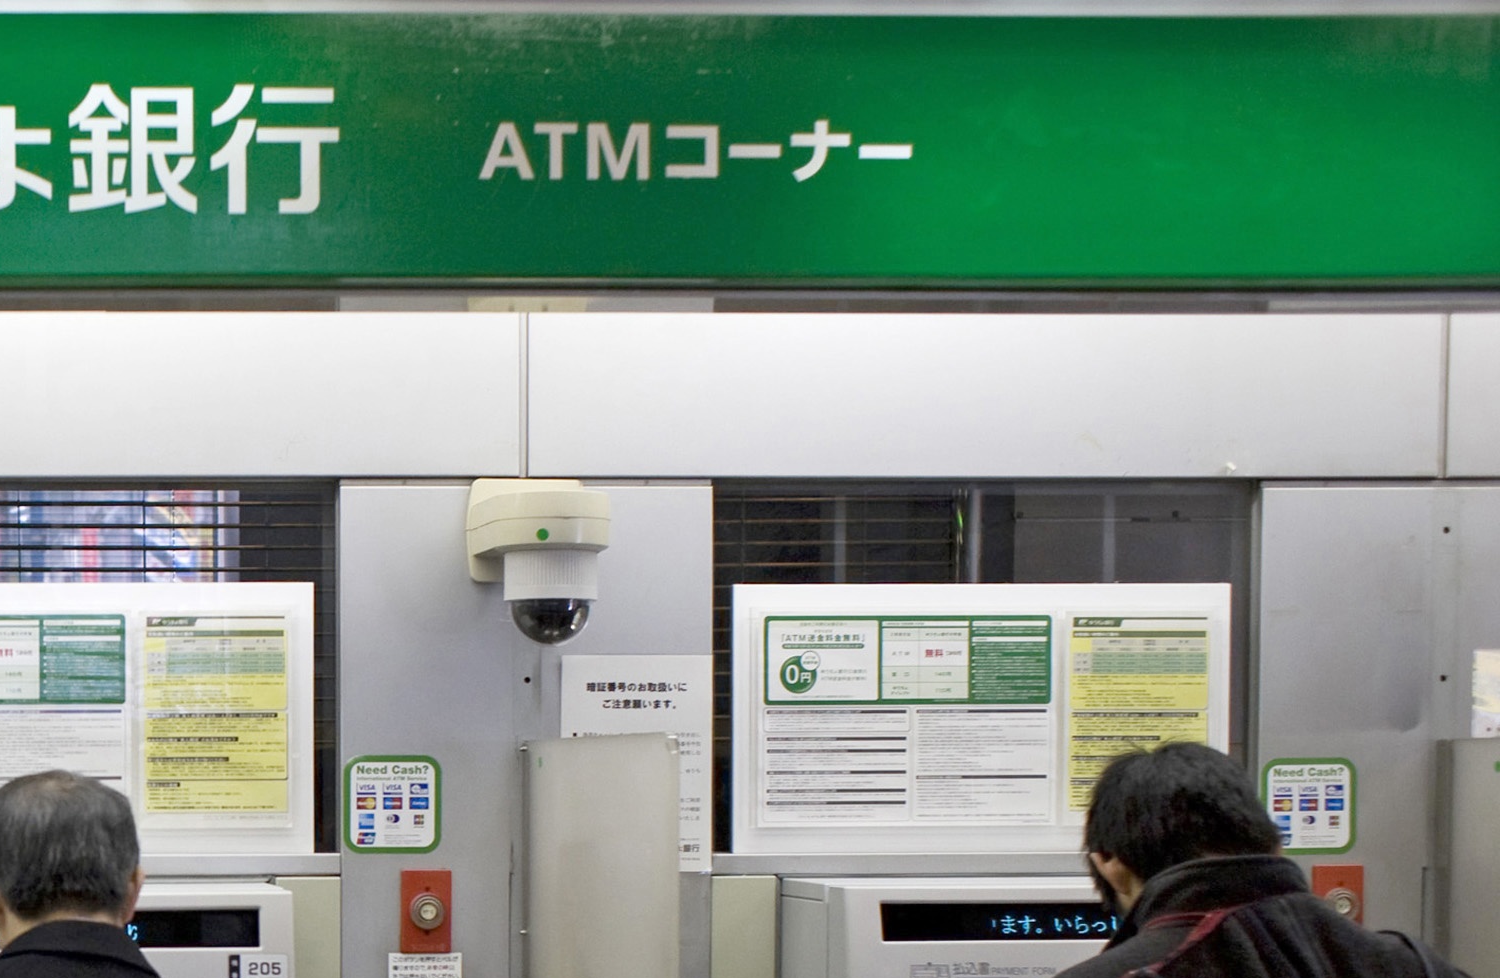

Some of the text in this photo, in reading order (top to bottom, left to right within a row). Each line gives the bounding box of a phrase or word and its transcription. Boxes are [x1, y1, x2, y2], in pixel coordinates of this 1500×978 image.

[478, 119, 916, 184] ATMコーナー
[781, 633, 866, 643] 「ATM送金料金無料」
[586, 682, 688, 692] 暗証番号のお取扱いに
[602, 699, 677, 709] ご注意願います。
[356, 765, 429, 774] Need Cash?
[1273, 767, 1344, 777] Need Cash?
[247, 961, 282, 976] 205
